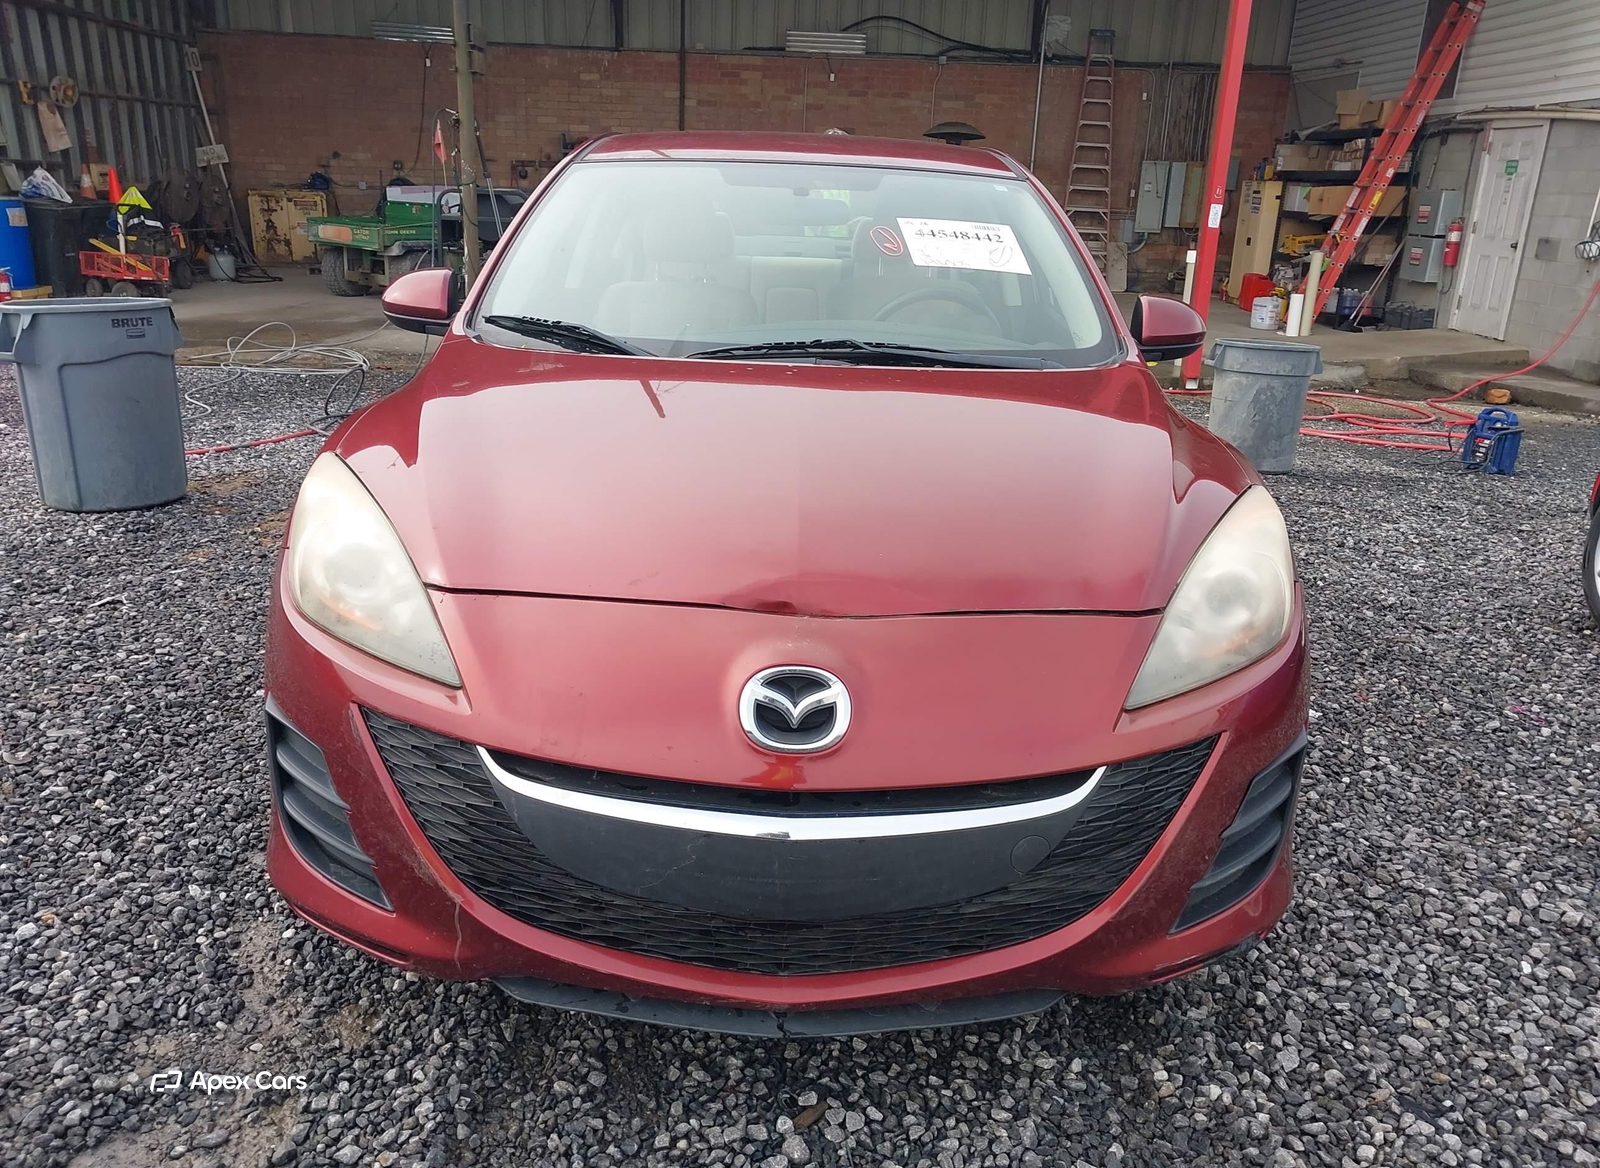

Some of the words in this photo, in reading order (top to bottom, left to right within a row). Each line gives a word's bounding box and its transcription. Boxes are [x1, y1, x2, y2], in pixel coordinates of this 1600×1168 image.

[202, 147, 216, 156] NO
[914, 228, 1004, 243] 44548442
[111, 316, 153, 328] BRUTE
